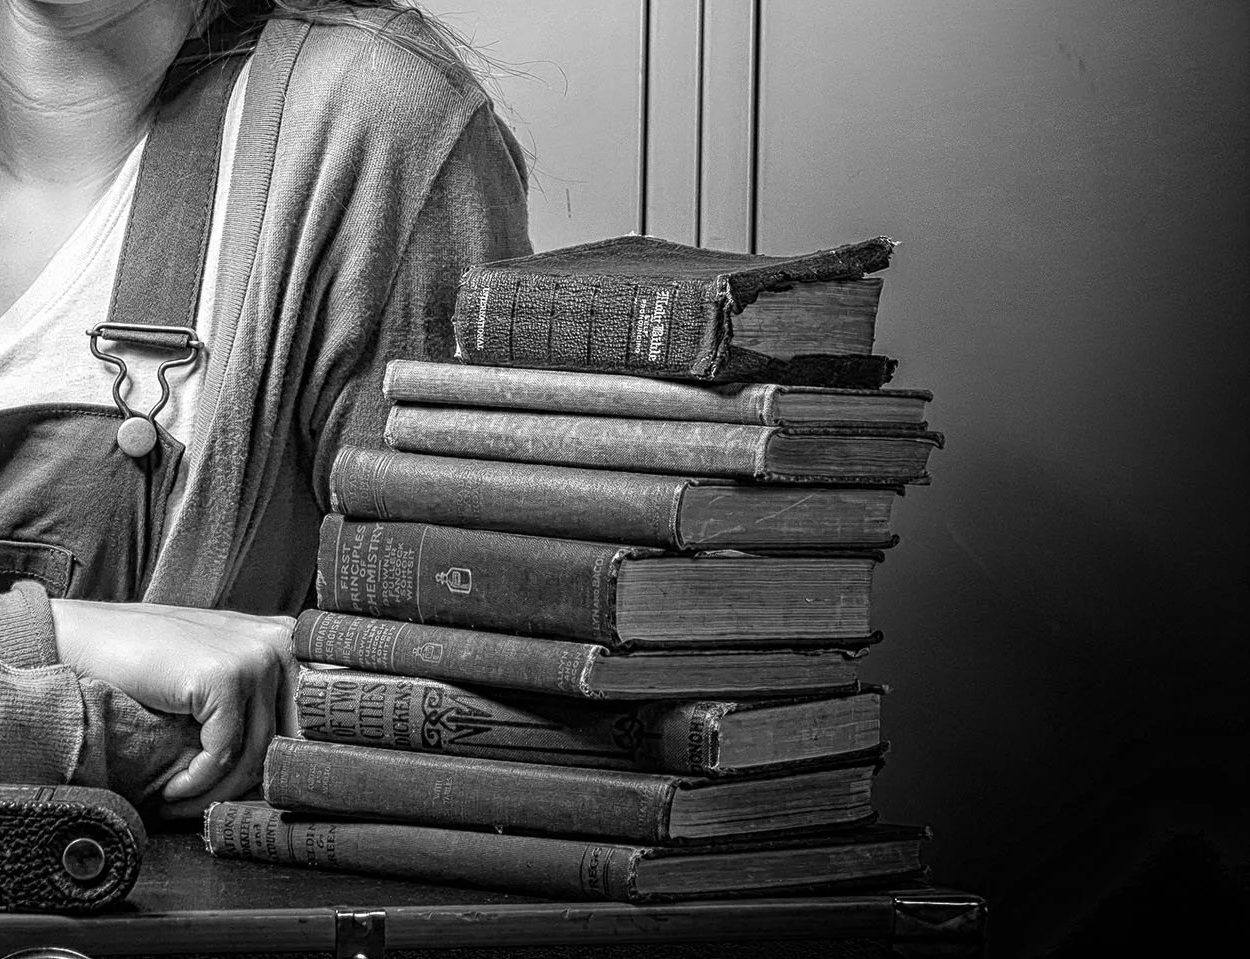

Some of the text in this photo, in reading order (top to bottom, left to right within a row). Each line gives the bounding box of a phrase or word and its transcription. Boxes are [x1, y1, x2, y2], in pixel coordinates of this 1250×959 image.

[477, 286, 491, 351] INTERNATIONAL
[647, 324, 664, 362] Bible
[341, 543, 351, 590] FIRST
[350, 524, 367, 611] PRINCIPLES
[359, 560, 367, 578] OF
[366, 523, 383, 617] CHEMISTRY
[382, 537, 394, 606] BROWNLEE
[389, 547, 398, 598] FULLER
[394, 542, 404, 603] HANCOCK
[400, 551, 409, 597] SOHON
[406, 548, 415, 600] WHITSIT
[326, 615, 346, 661] XERCISES
[341, 617, 363, 663] HEMISTRY
[330, 681, 358, 737] OF TWO
[359, 683, 387, 739] CITIES
[392, 681, 413, 747] DICKENS
[223, 808, 238, 850] ATIONAL
[253, 823, 263, 848] and
[306, 823, 317, 859] ELDIN
[326, 824, 338, 860] REEN
